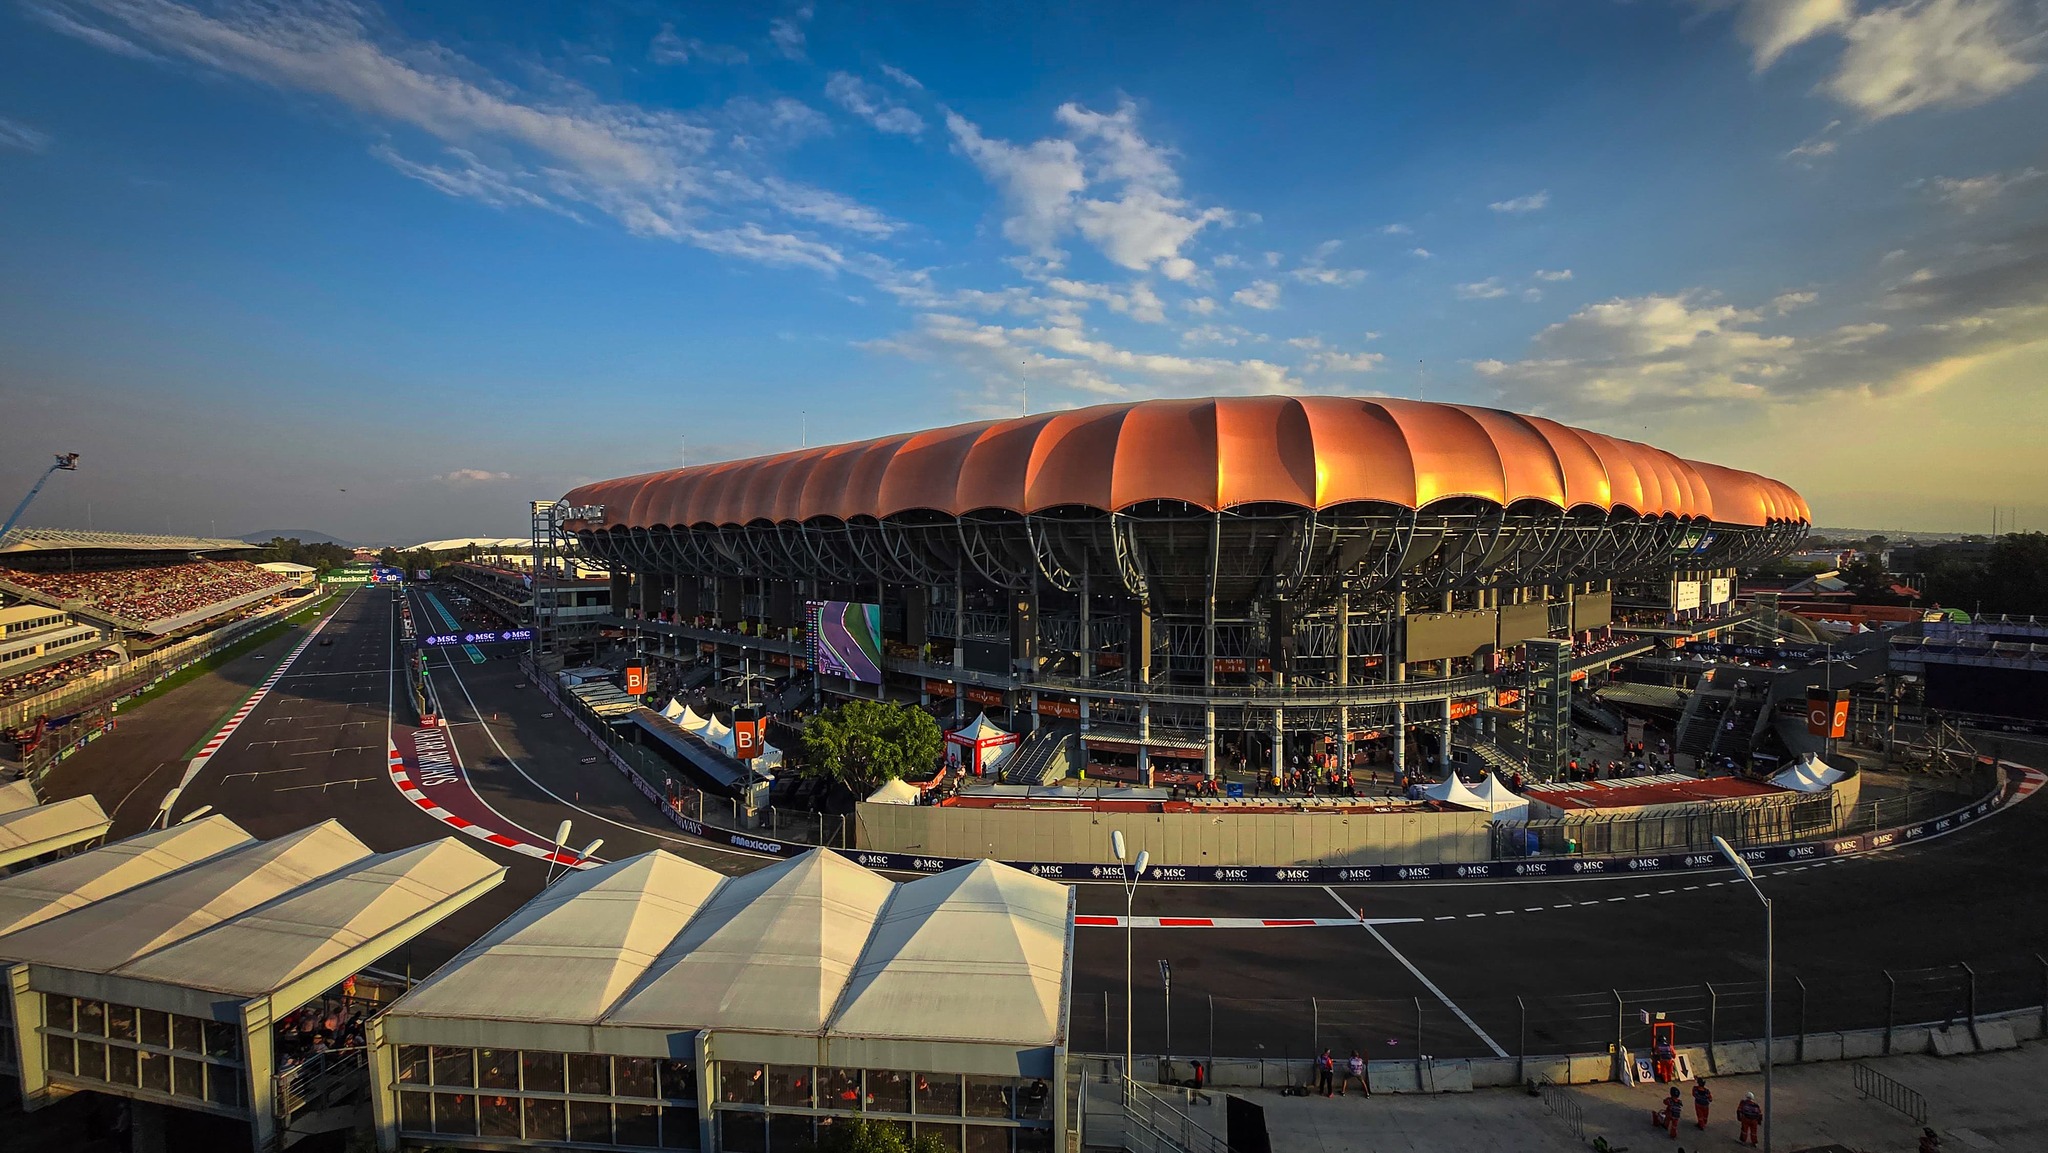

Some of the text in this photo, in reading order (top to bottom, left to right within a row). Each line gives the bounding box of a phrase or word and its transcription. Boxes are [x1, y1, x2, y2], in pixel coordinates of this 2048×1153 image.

[630, 675, 640, 686] B
[1811, 710, 1825, 726] C
[1834, 712, 1845, 727] C
[739, 732, 752, 747] B
[759, 728, 764, 745] B
[411, 728, 458, 786] QATAR AIRWAYS
[661, 802, 702, 835] QATAR AIRWAYS
[1940, 819, 1950, 828] MSC
[1912, 827, 1923, 835] MSC
[1879, 834, 1892, 842] MSC
[731, 835, 781, 852] #MexicoGP
[1746, 851, 1766, 859] MSC
[1797, 847, 1814, 855] MSC
[868, 855, 888, 864] MSC
[1639, 859, 1659, 867] MSC
[1694, 855, 1713, 863] MSC
[923, 860, 944, 868] MSC
[1526, 864, 1546, 872] MSC
[1583, 862, 1603, 870] MSC
[1041, 866, 1062, 874] MSC
[1102, 867, 1124, 875] MSC
[1164, 869, 1186, 877] MSC
[1226, 870, 1247, 878] MSC
[1350, 870, 1370, 878] MSC
[1409, 868, 1430, 876] MSC
[1468, 866, 1488, 874] MSC
[1287, 870, 1309, 879] MSC
[1640, 1061, 1651, 1079] SC
